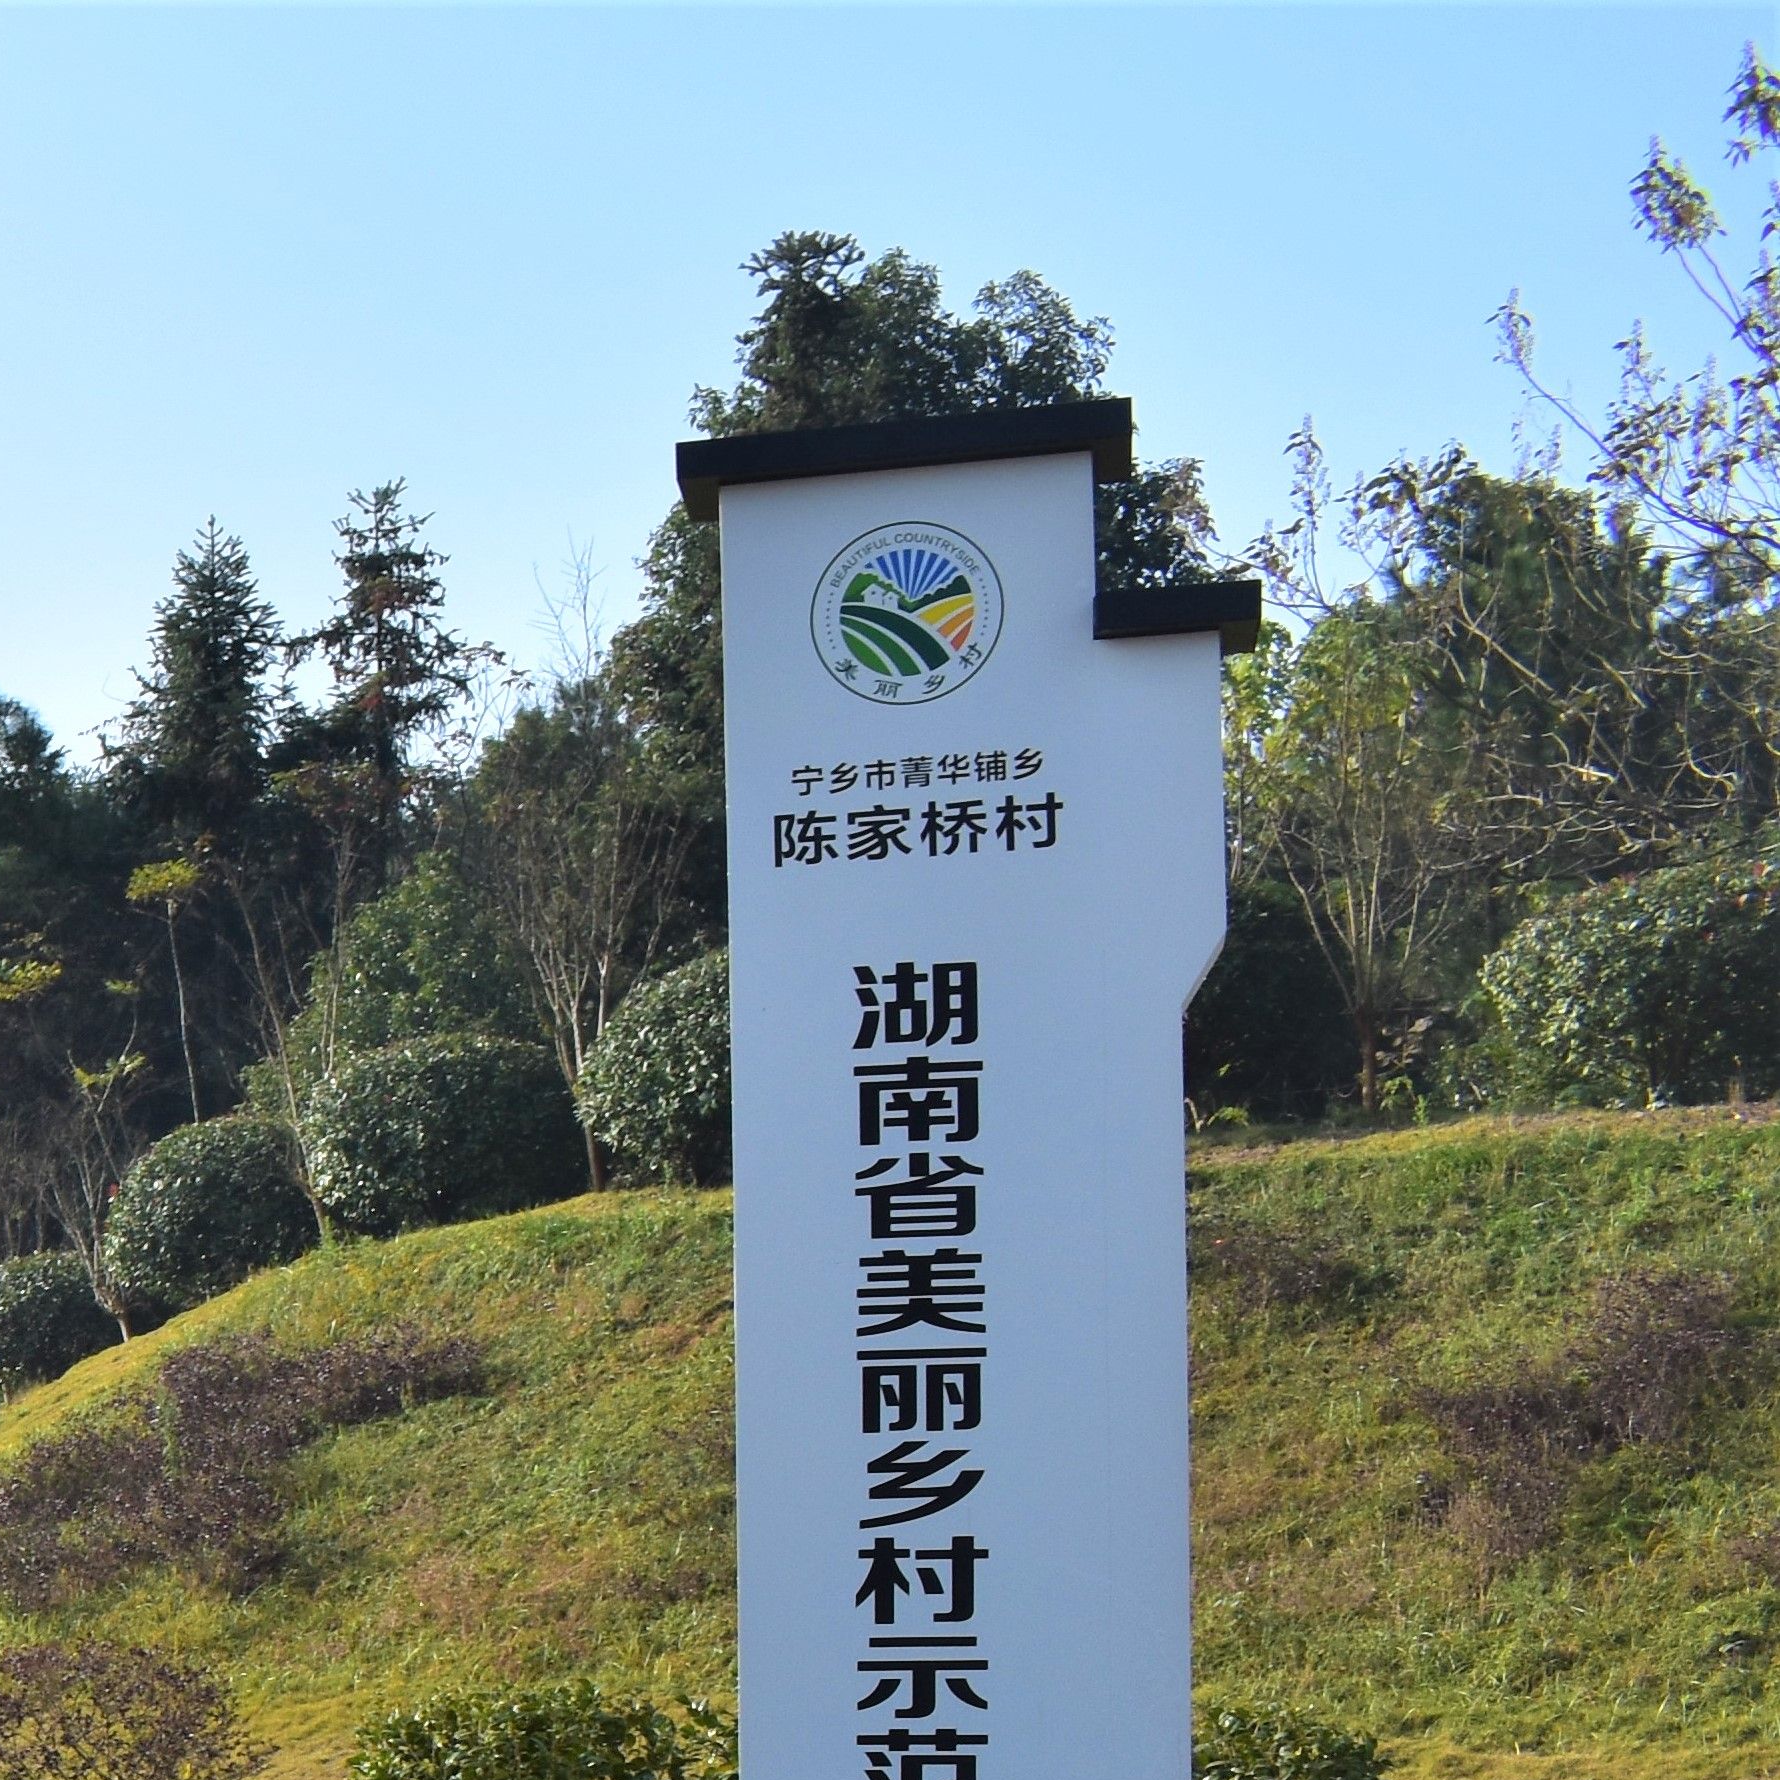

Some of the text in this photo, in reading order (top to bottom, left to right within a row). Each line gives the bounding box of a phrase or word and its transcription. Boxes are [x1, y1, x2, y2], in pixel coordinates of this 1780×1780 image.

[829, 532, 982, 589] BEAUTIFUL COUNTRYSIDE
[834, 642, 983, 699] 美丽乡村
[791, 748, 1044, 796] 宁乡市菁华铺乡
[773, 791, 1064, 867] 陈家桥村
